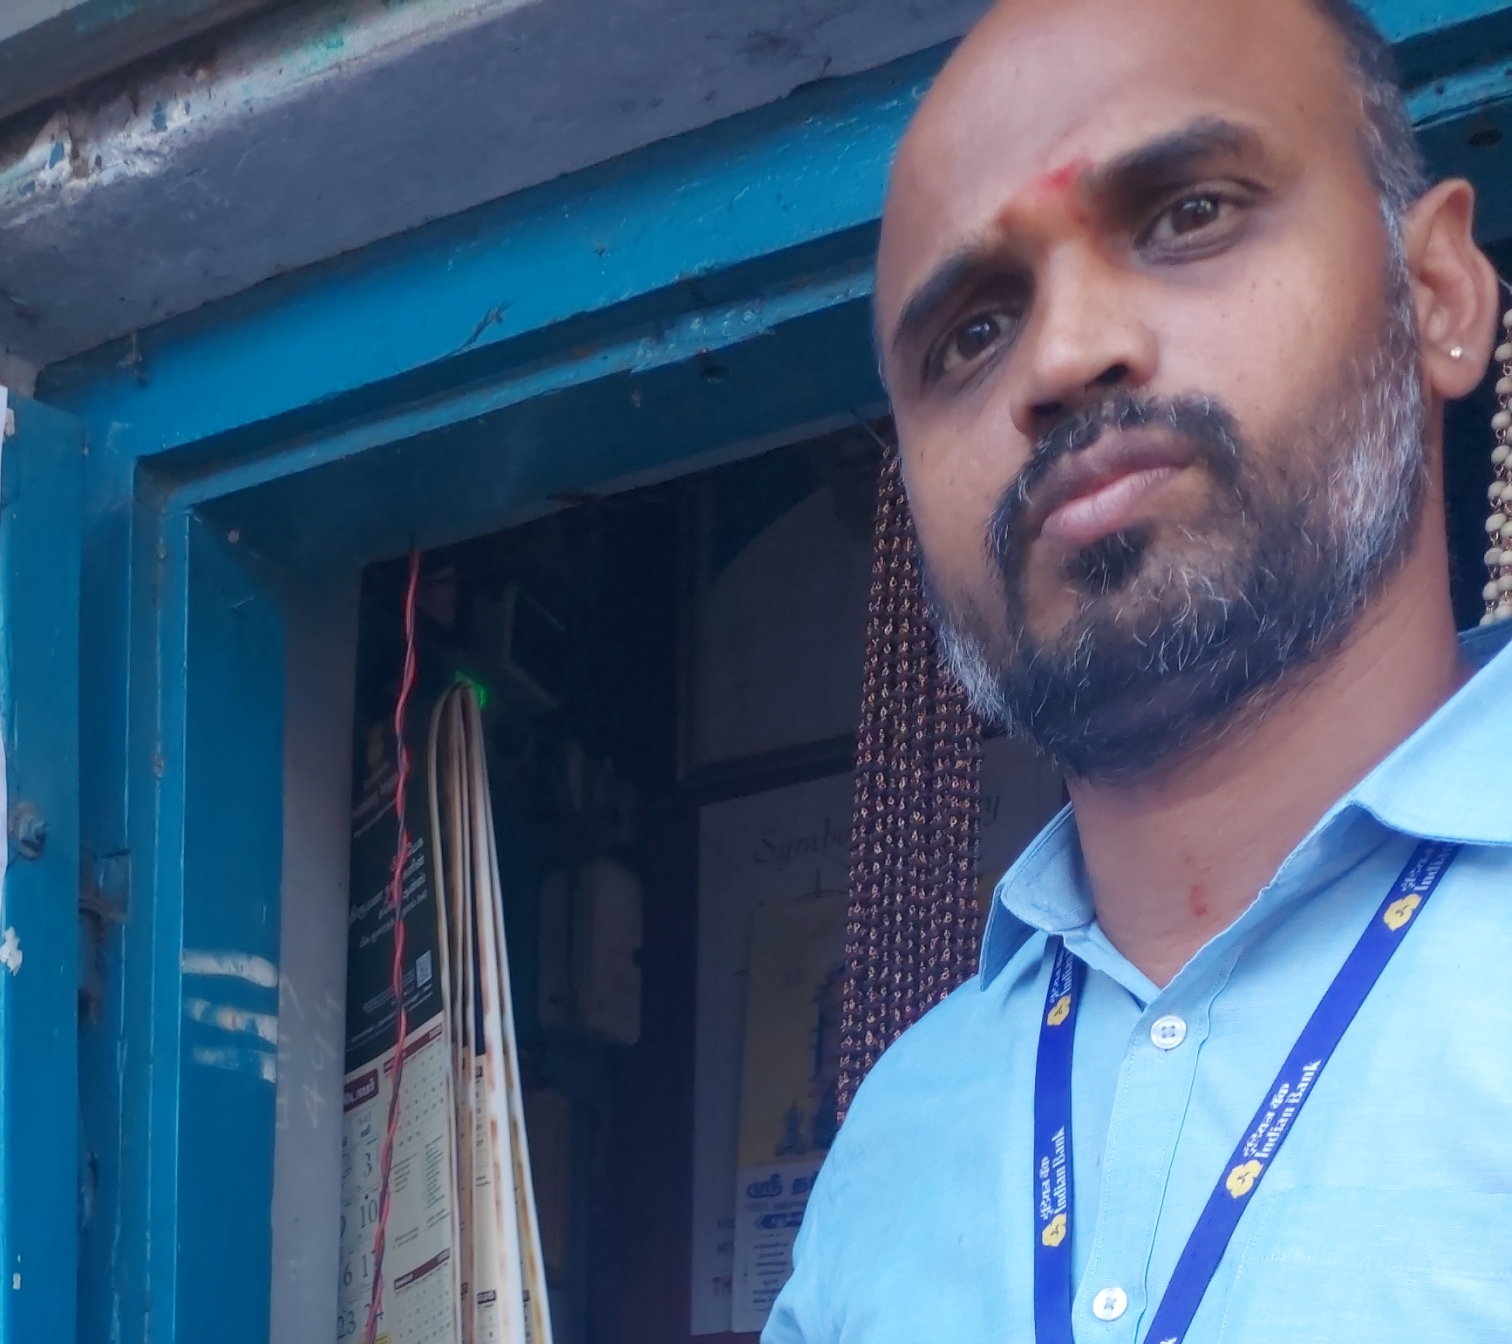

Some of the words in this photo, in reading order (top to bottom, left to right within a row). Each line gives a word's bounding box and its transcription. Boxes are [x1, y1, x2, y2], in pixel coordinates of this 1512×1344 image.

[1254, 1107, 1295, 1158] Indian
[1285, 1060, 1321, 1104] Bank
[1051, 1125, 1066, 1169] Bank
[1053, 1165, 1066, 1215] Indian
